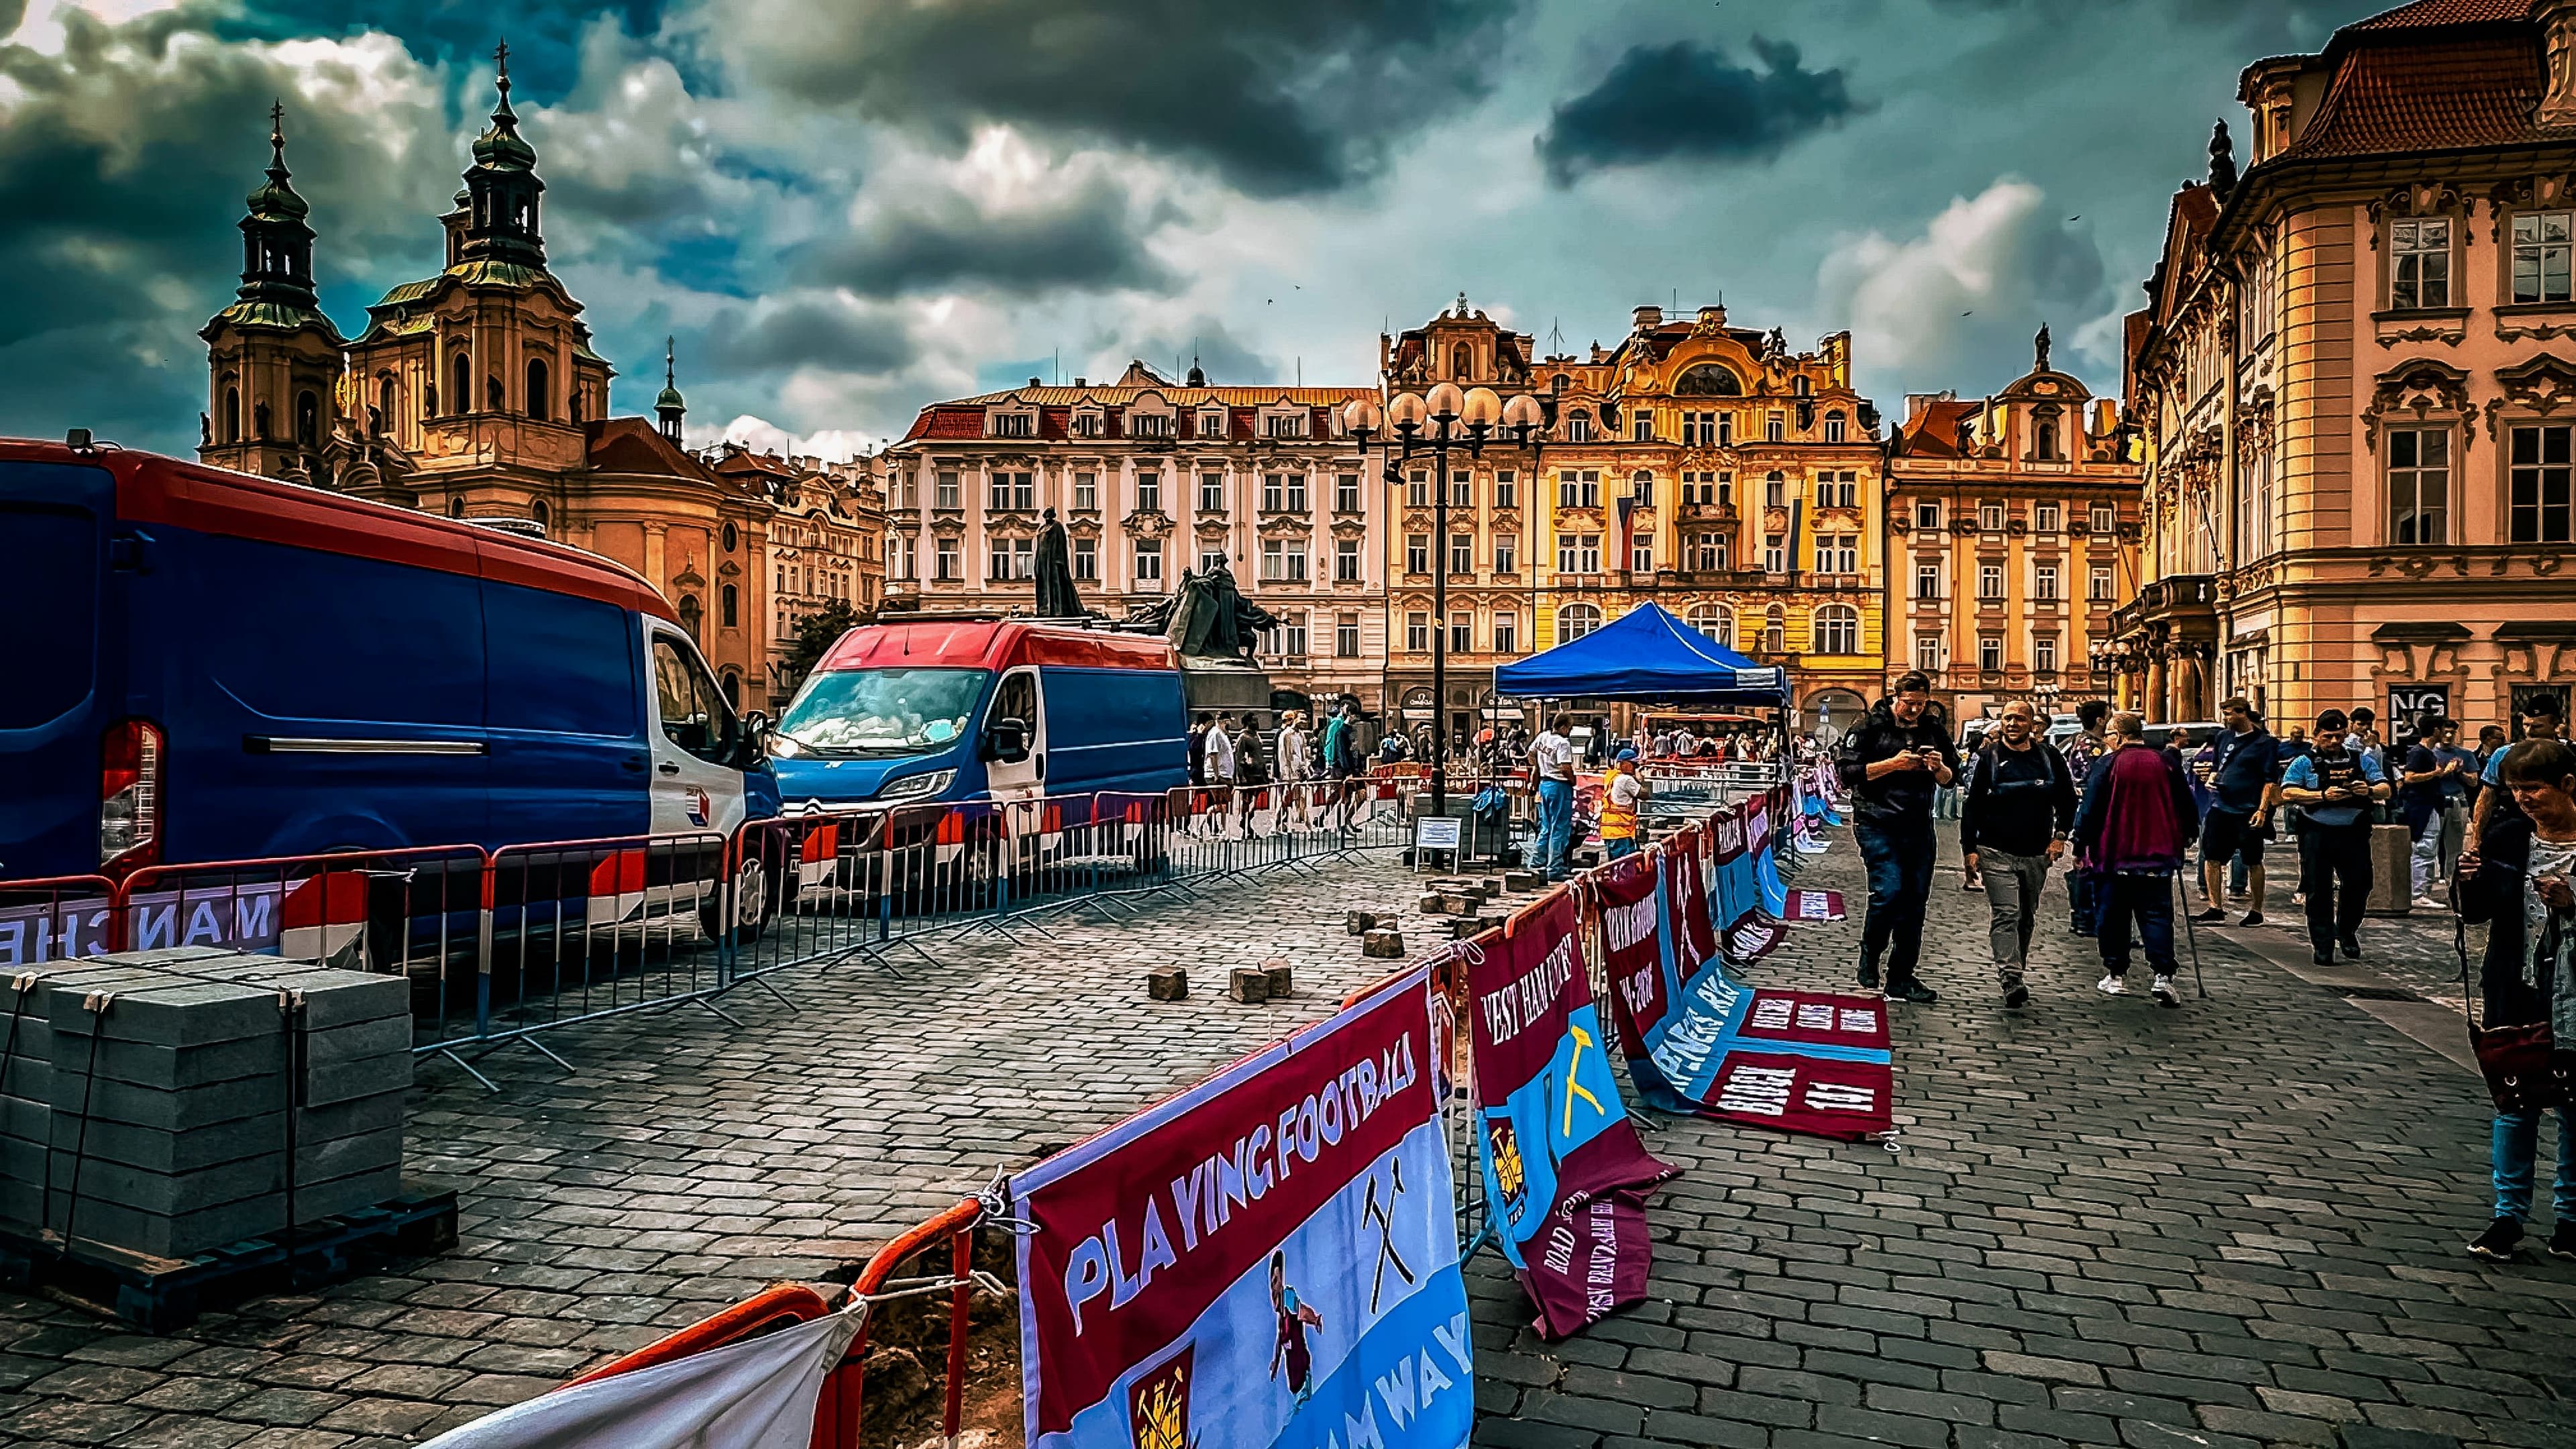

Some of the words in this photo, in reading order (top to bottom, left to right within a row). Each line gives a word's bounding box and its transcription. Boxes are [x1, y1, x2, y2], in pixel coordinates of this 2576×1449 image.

[2391, 693, 2444, 717] NG
[1519, 962, 1549, 1028] HAM
[1716, 1065, 1796, 1116] BLOCK
[1804, 1081, 1875, 1112] 141
[1065, 1124, 1274, 1338] PLAYING
[1543, 1226, 1576, 1275] ROAD
[1375, 1311, 1472, 1432] WAY
